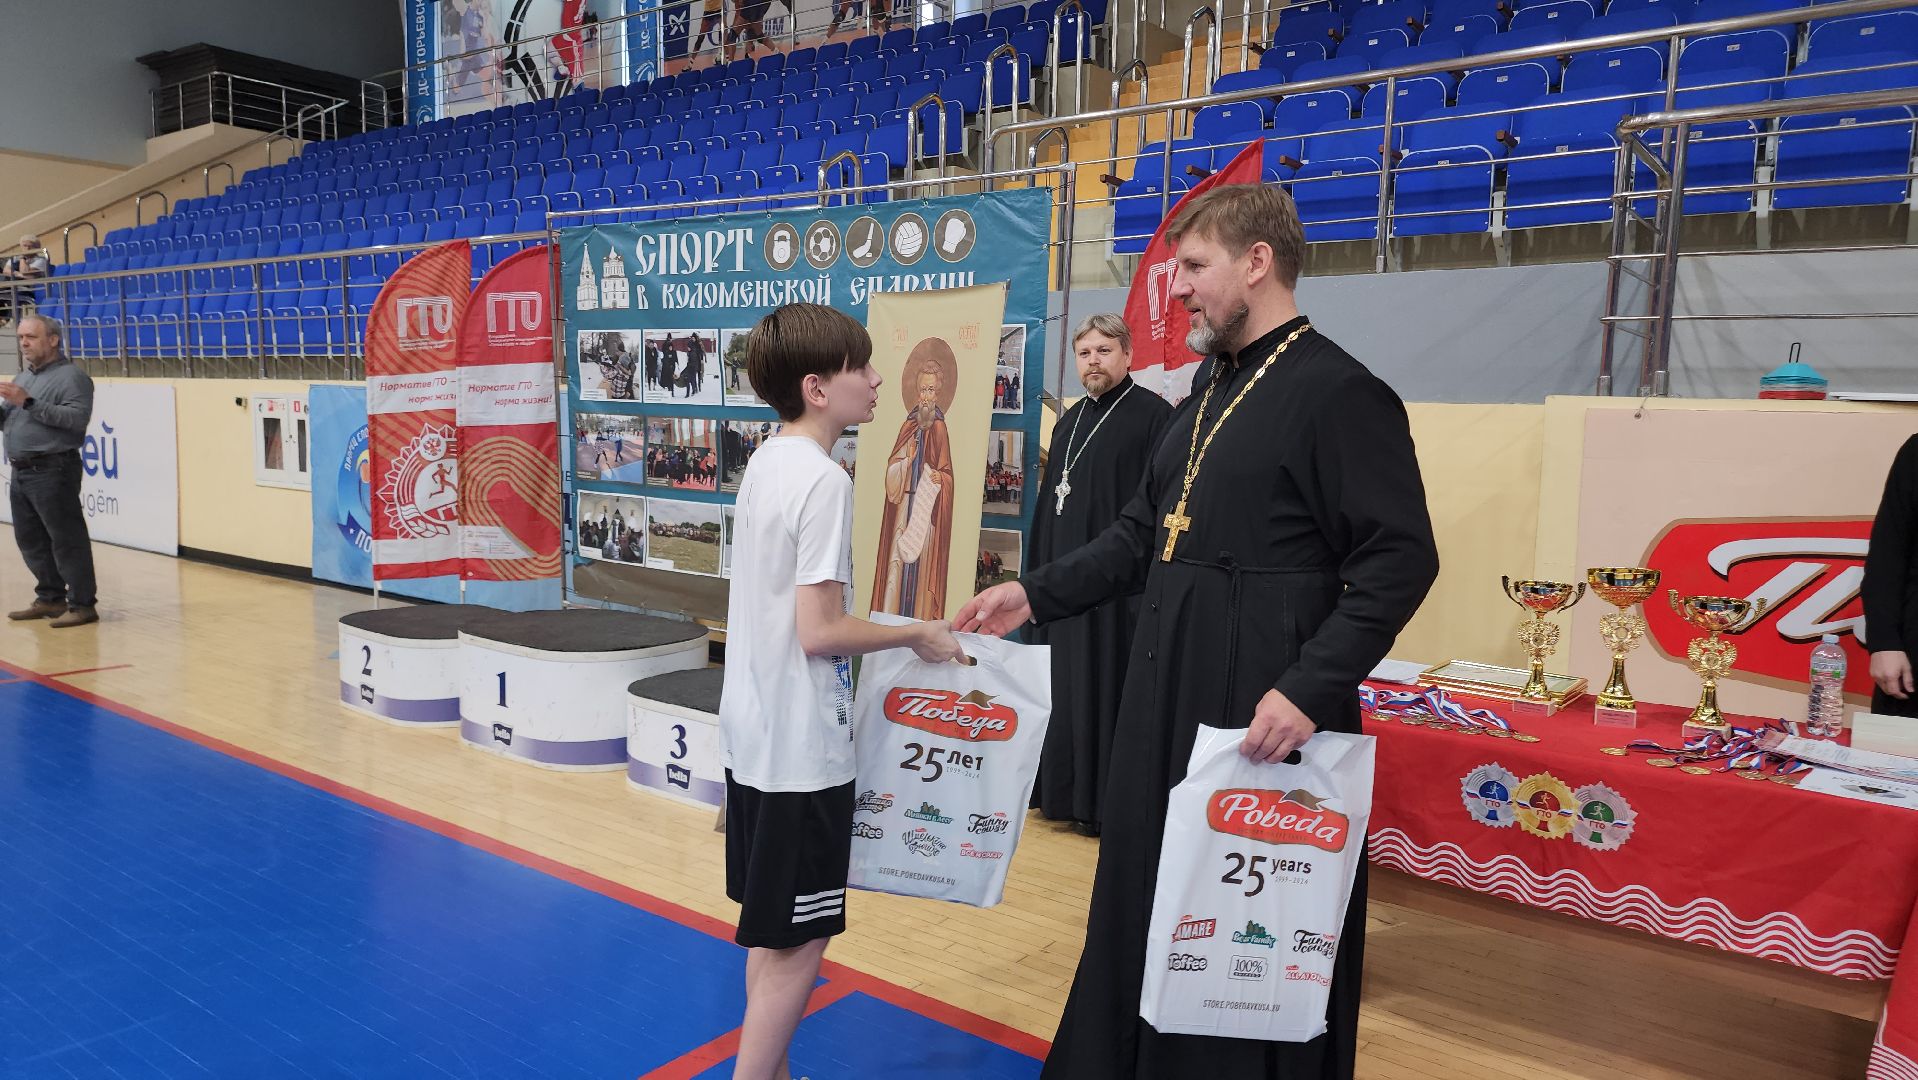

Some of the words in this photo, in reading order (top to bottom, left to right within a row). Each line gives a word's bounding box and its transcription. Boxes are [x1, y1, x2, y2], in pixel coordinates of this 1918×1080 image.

[635, 228, 753, 276] СПОРТ
[662, 273, 832, 309] КОЛОМЕНСКОЙ
[396, 295, 453, 338] ГТО
[486, 291, 542, 333] ГТО
[494, 398, 520, 408] норма
[521, 394, 553, 405] жизни!
[517, 381, 533, 391] ГТО
[361, 644, 373, 677] 2
[495, 671, 510, 709] 1
[897, 692, 1008, 739] Победа
[670, 724, 688, 760] 3
[668, 768, 689, 783] bella
[900, 742, 946, 783] 25
[946, 750, 984, 771] лет
[1218, 792, 1342, 844] Pobeda
[1485, 799, 1501, 808] ГТО
[1536, 809, 1552, 819] ГТО
[852, 821, 883, 839] offee
[968, 813, 1009, 833] Funny
[1589, 820, 1606, 830] ГТО
[1221, 852, 1268, 898] 25
[1270, 858, 1312, 876] years
[1168, 952, 1208, 971] Toffee
[1233, 959, 1264, 974] 100%
